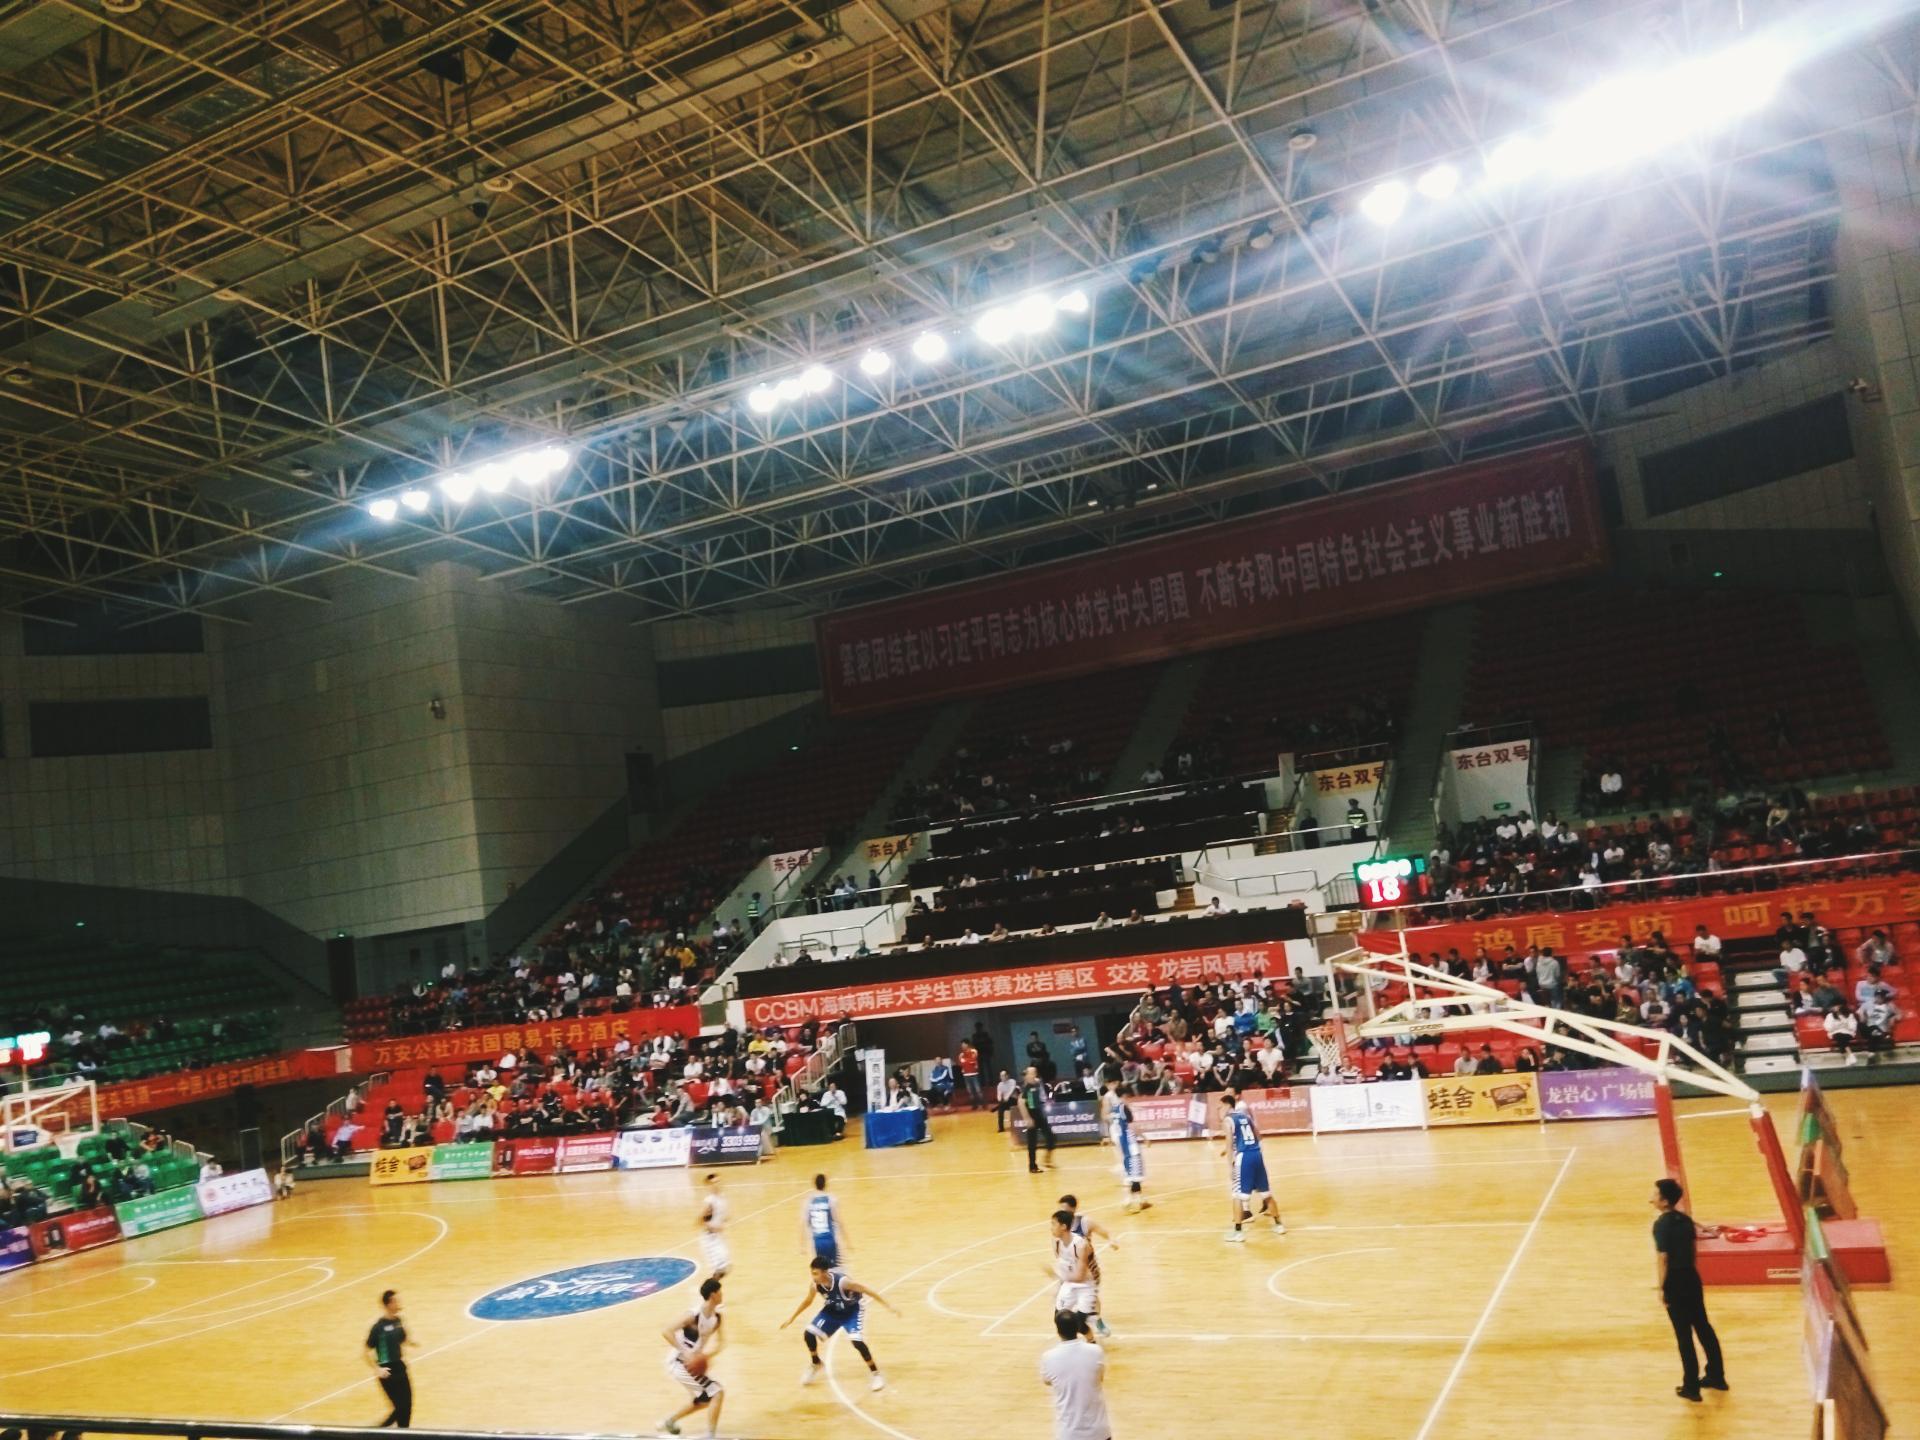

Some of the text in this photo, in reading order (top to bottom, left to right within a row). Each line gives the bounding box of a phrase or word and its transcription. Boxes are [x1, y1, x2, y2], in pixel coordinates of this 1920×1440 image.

[839, 484, 1571, 687] 紧密团结在以习近平同志为核心的党中央周围 不断夺取中国特色社会主义事业新胜利
[1455, 745, 1530, 770] 东台双号
[1368, 877, 1401, 903] 18
[1473, 911, 1675, 951] 鸿盾安防
[1427, 1084, 1475, 1110] 蛙舍
